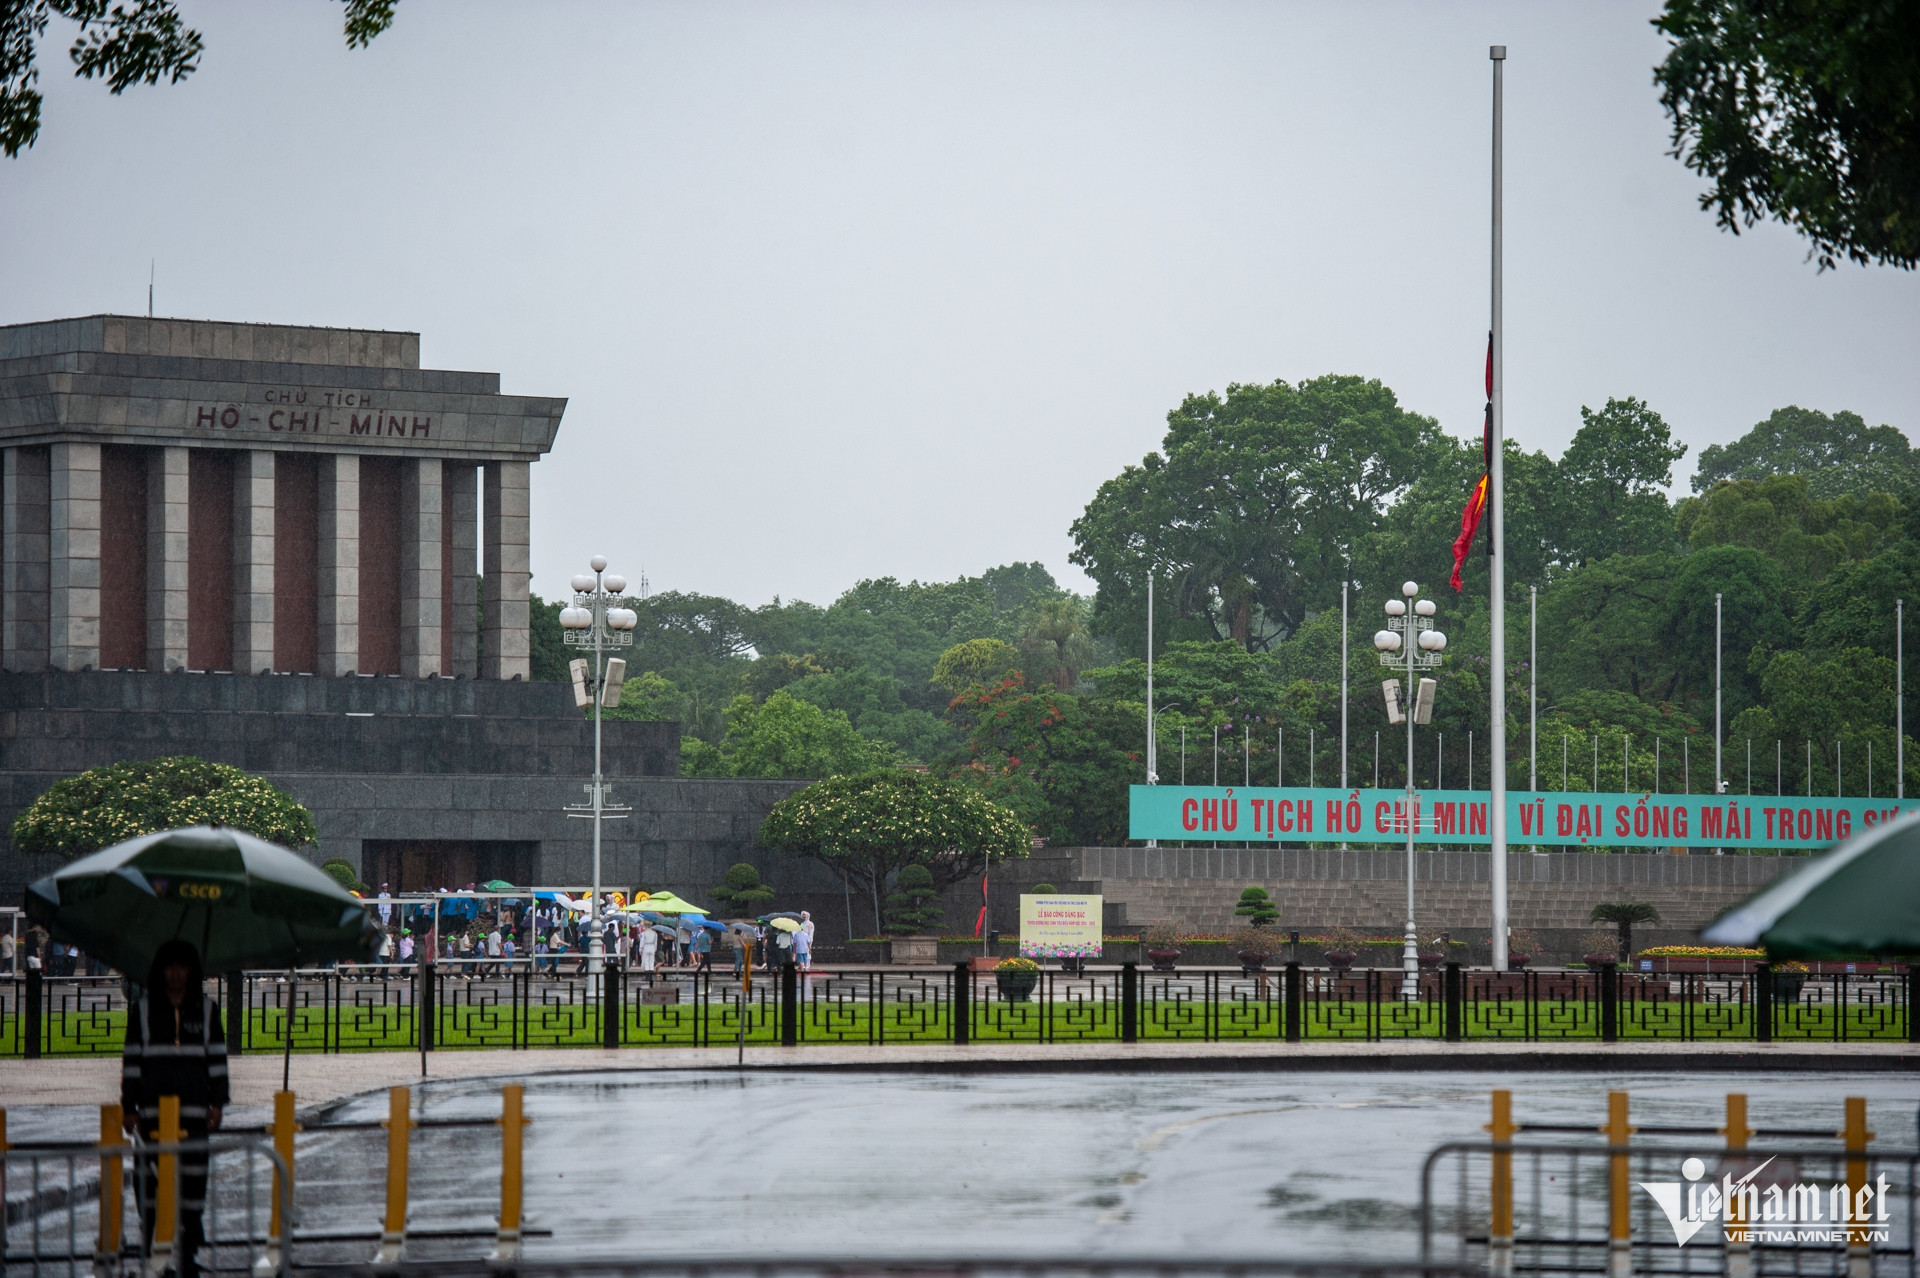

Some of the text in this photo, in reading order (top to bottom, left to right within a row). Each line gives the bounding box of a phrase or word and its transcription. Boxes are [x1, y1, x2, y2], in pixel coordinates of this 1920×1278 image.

[196, 403, 242, 429] HỒ
[350, 409, 431, 438] MINH
[1182, 788, 1238, 832] CHỦ
[1251, 799, 1313, 839] TỊCH
[1326, 789, 1362, 833] HỒ
[1433, 801, 1493, 836] MIN
[1519, 798, 1544, 836] VĨ
[1556, 803, 1602, 843] ĐẠI
[1615, 794, 1688, 839] SỐNG
[1701, 801, 1751, 840] MÃI
[1763, 807, 1851, 841] TRONG
